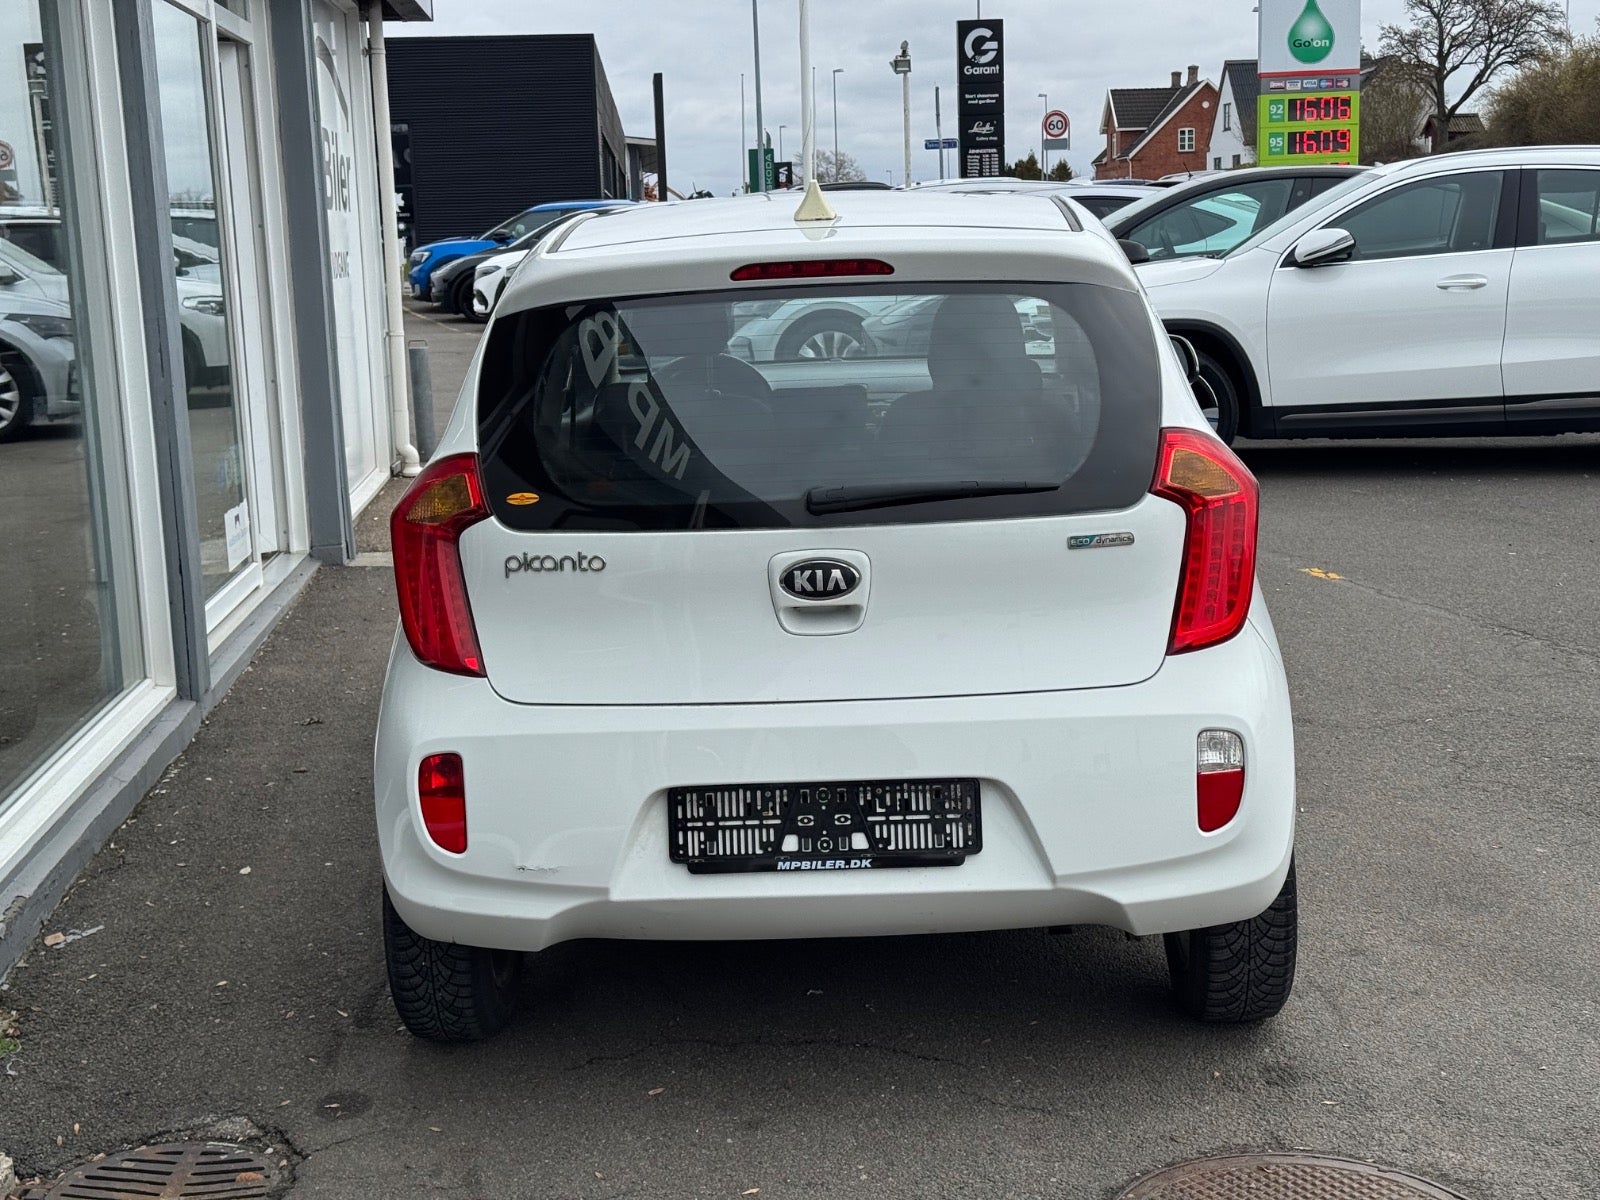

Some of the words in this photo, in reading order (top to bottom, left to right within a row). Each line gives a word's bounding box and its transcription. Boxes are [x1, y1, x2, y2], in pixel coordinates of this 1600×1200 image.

[1292, 38, 1330, 48] Go'on
[963, 64, 1000, 75] Garant
[1269, 104, 1284, 114] 92
[1048, 120, 1064, 130] 60
[1269, 138, 1283, 148] 95
[322, 127, 351, 213] Biler
[504, 551, 607, 579] picanto
[793, 568, 848, 592] KIA
[776, 858, 873, 871] MPBILER.DK
